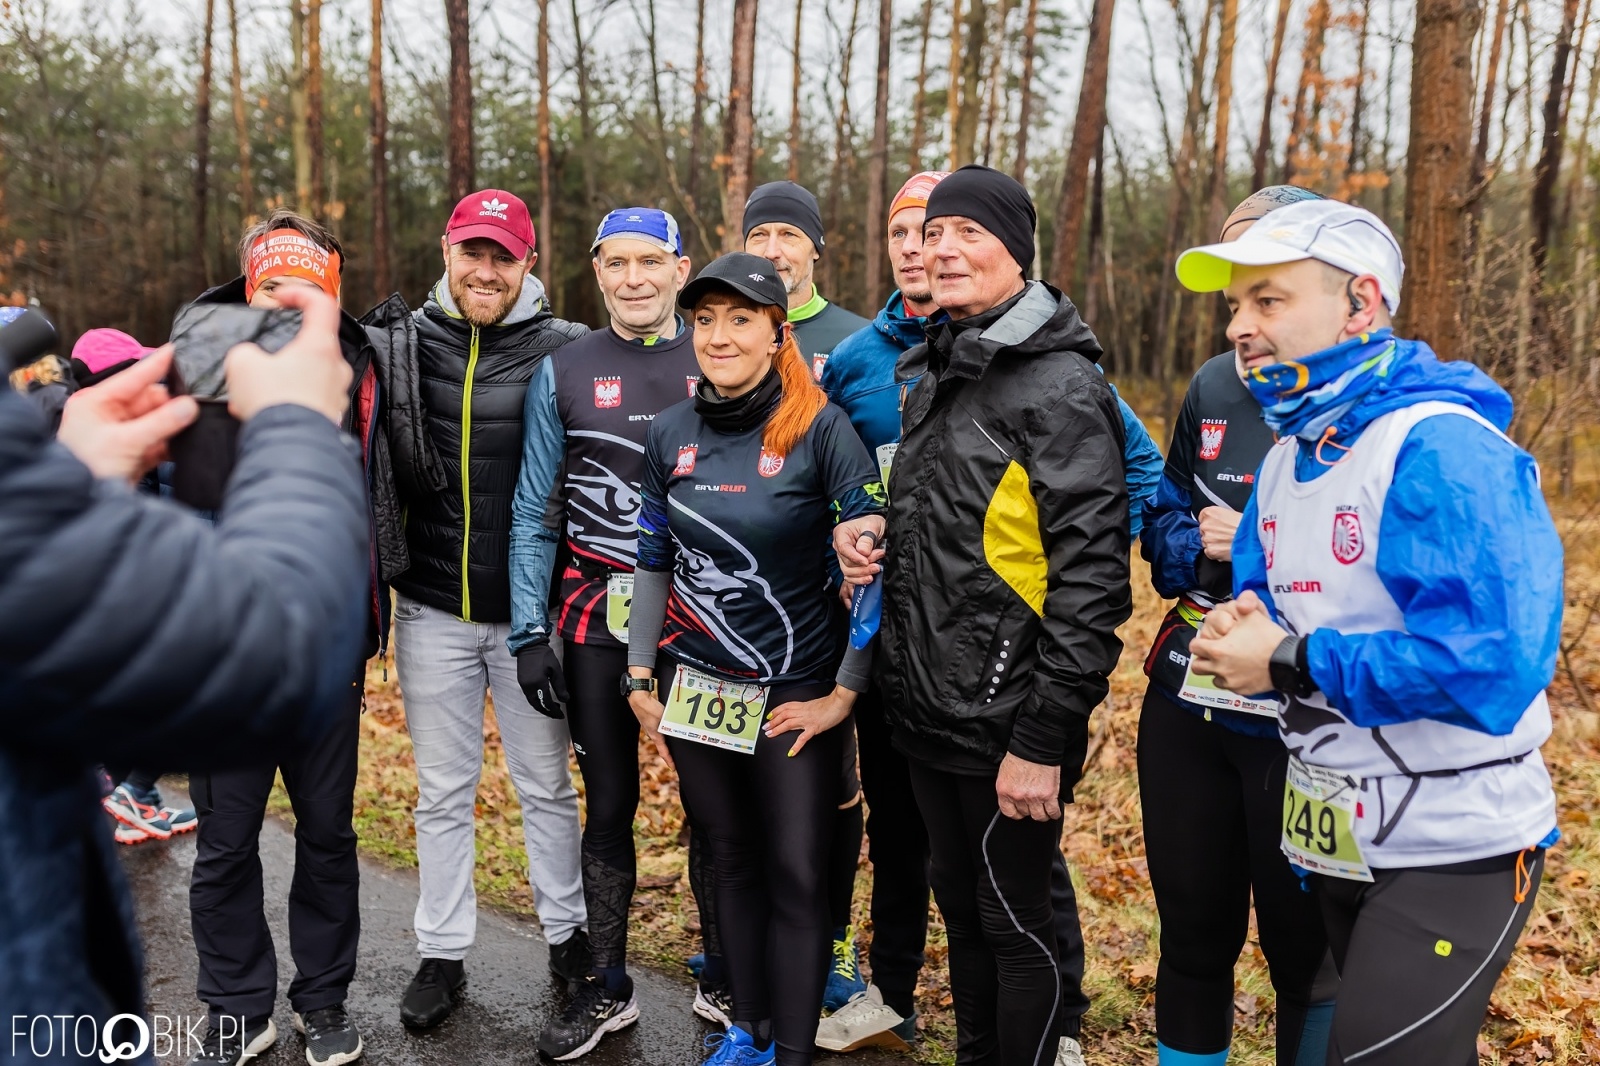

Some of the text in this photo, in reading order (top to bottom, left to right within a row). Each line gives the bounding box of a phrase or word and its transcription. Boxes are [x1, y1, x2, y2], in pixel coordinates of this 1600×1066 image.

[479, 209, 507, 221] adidas
[253, 244, 329, 267] ULTRAMARATON
[254, 255, 325, 280] BABIA GÓRA
[748, 273, 765, 282] 4F
[628, 414, 656, 422] EAZY
[686, 692, 748, 735] 193
[1286, 789, 1336, 856] 249
